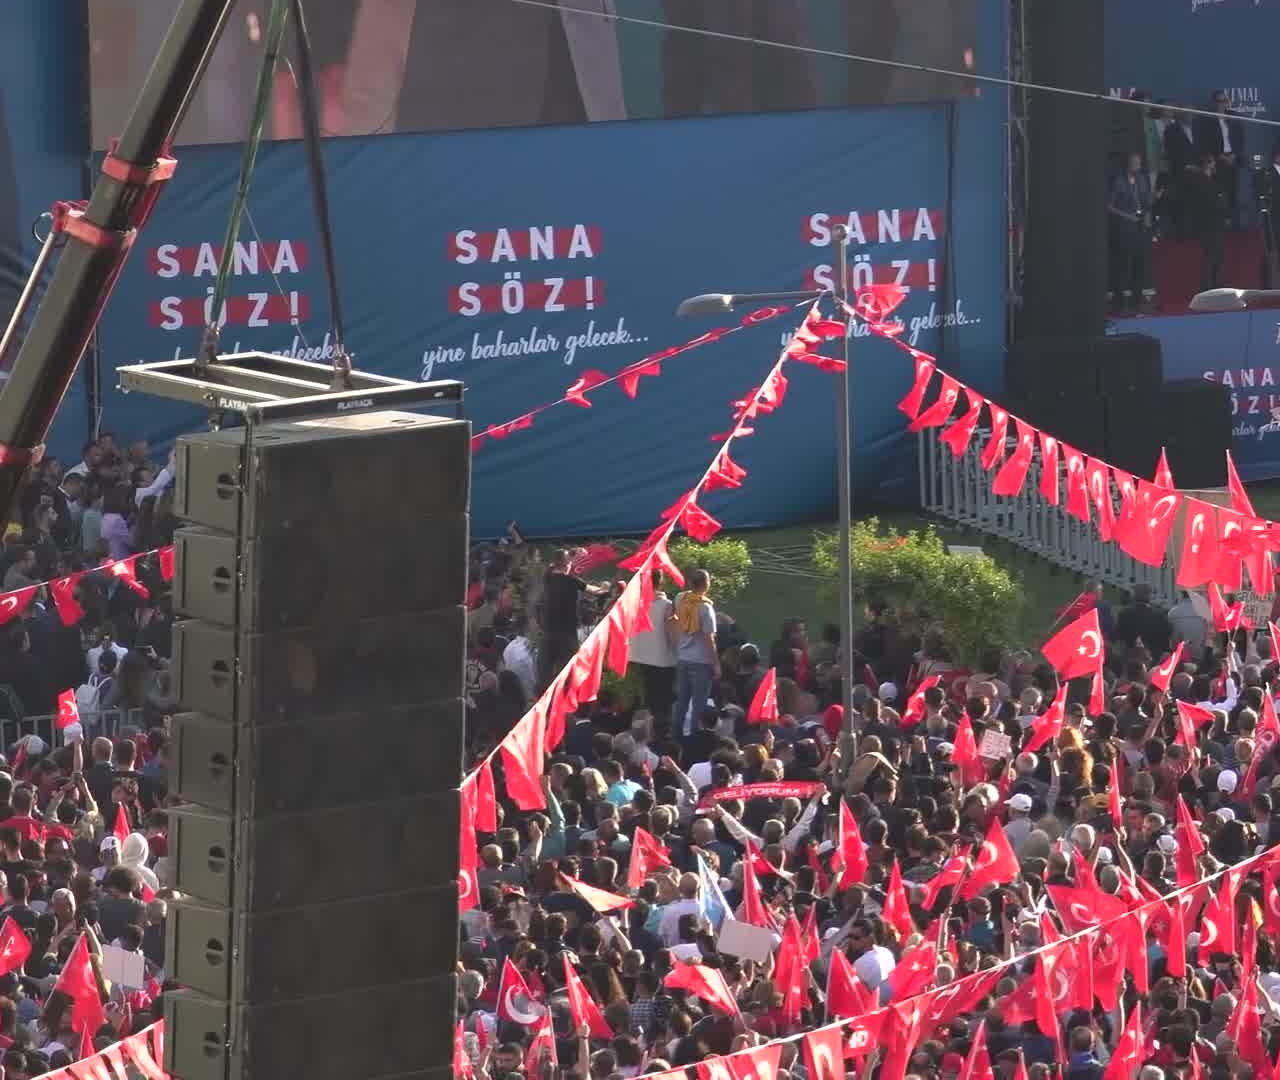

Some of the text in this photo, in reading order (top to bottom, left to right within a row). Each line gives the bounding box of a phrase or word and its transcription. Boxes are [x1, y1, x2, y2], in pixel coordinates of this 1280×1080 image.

[455, 225, 594, 264] SANA
[810, 207, 936, 247] SANA
[157, 239, 299, 278] SANA
[459, 271, 594, 316] SÖZ!
[422, 345, 466, 379] yine
[471, 326, 559, 358] baharlar
